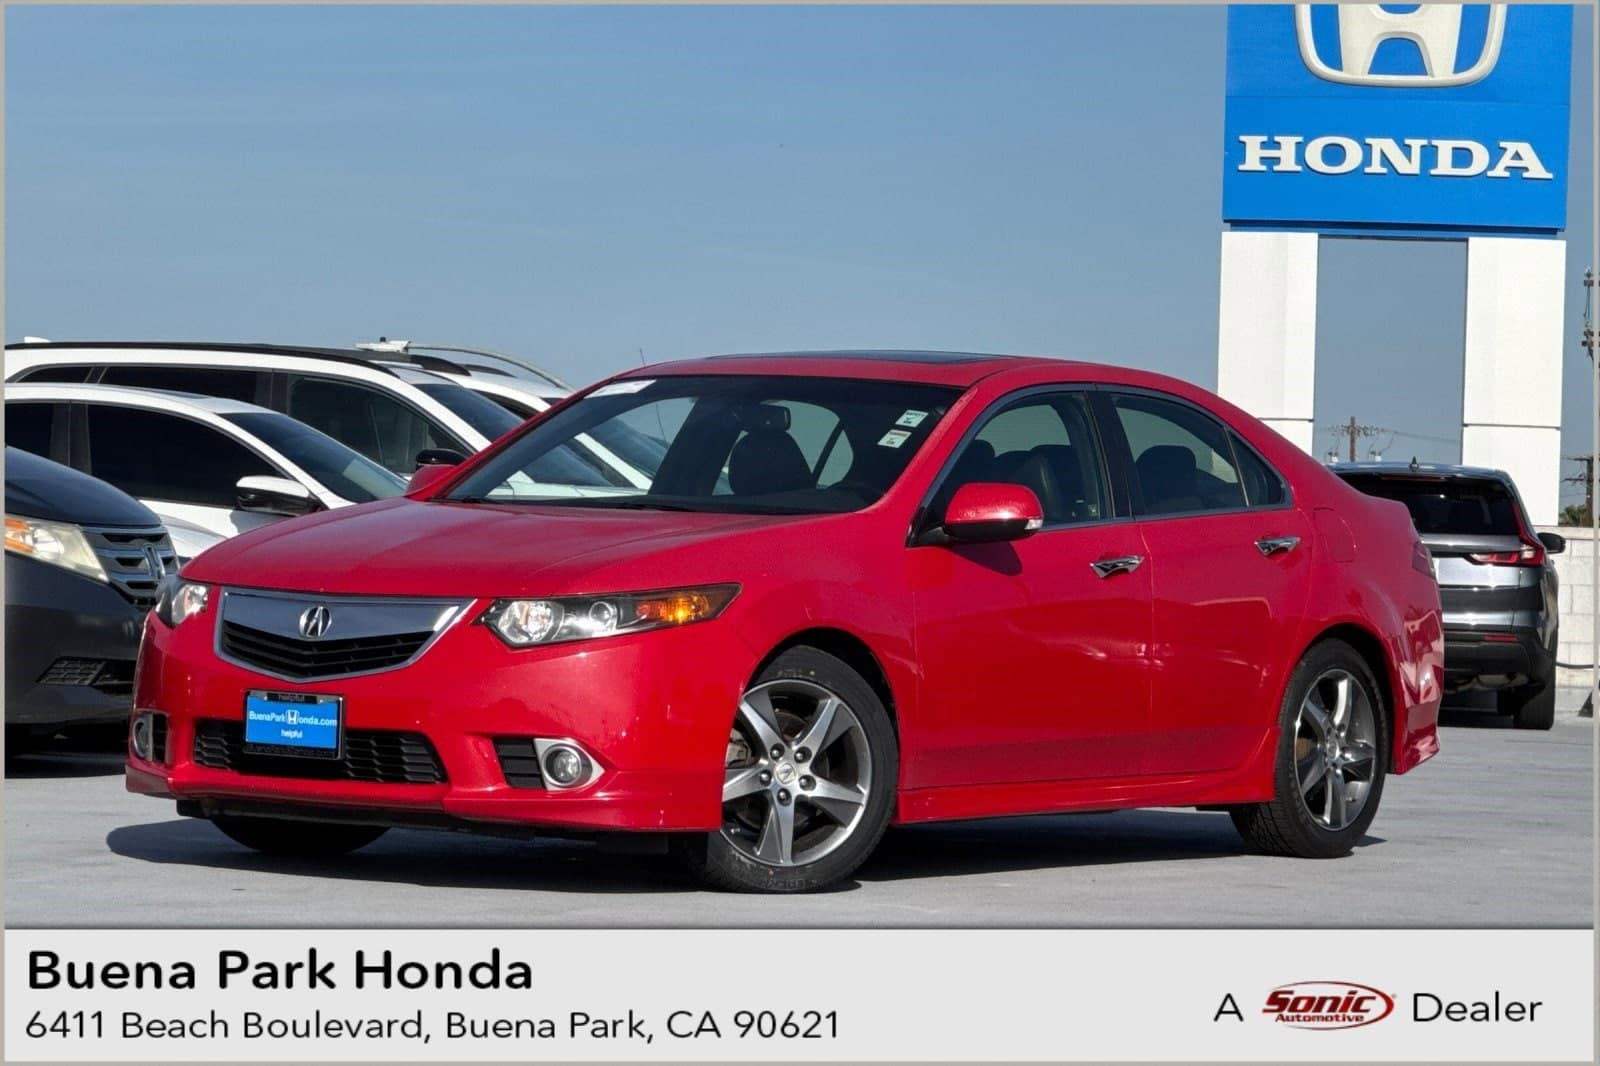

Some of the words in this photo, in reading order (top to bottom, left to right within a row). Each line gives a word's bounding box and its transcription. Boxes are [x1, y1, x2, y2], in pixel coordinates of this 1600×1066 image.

[1237, 135, 1553, 180] HONDA
[248, 709, 338, 728] BuenaParkHonda.com
[281, 729, 304, 739] helpful
